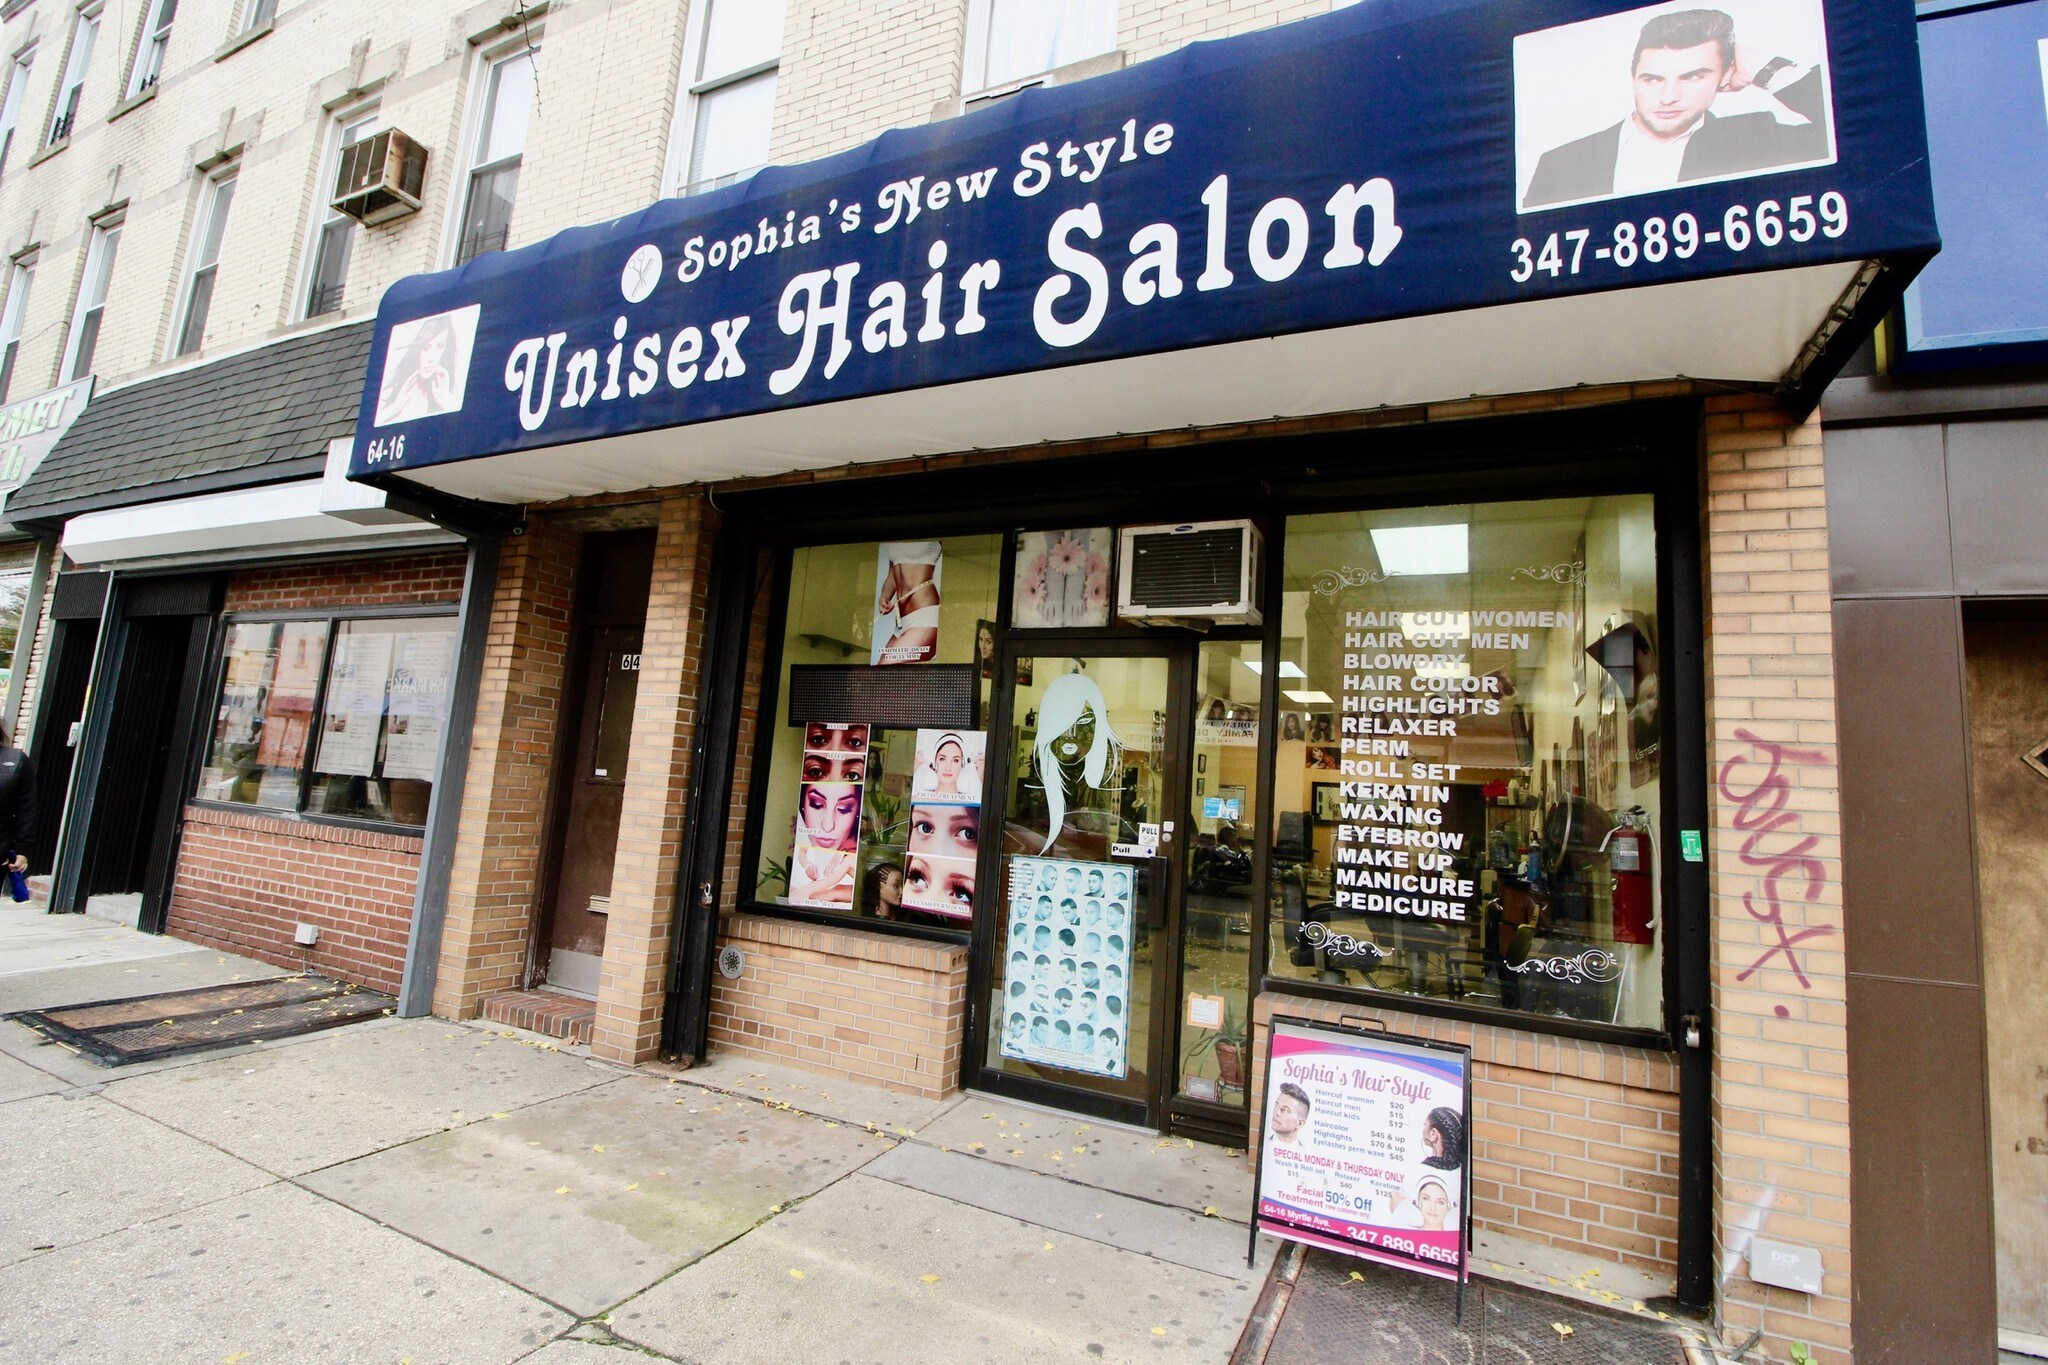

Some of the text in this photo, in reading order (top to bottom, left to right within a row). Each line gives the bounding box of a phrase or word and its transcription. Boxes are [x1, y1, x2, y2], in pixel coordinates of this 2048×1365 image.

[677, 118, 1174, 283] Sophia's New Style
[1509, 190, 1848, 283] 347-889-6659
[504, 174, 1402, 432] Unisex Hair Salon
[366, 434, 405, 466] 64-16
[1345, 611, 1574, 628] HAIR CUT WOMEN
[1344, 632, 1529, 650] HAIR CUT MEN
[1343, 654, 1466, 670] BLOWDRY
[1342, 675, 1499, 693] HAIR COLOR
[1342, 696, 1500, 716] HIGHLIGHTS
[1341, 717, 1457, 736] RELAXER
[1341, 738, 1409, 757] PERM
[1340, 759, 1462, 781] ROLL SET
[1339, 781, 1450, 803] KERATIN
[1340, 802, 1442, 825] WAXING
[1141, 826, 1158, 835] PULL
[1338, 824, 1464, 850] EYEBROW
[1337, 847, 1453, 871] MAKE UP
[1336, 868, 1474, 897] MANICURE
[1335, 890, 1466, 921] PEDICURE
[1283, 1057, 1432, 1104] Sophia's New Style
[1315, 1089, 1404, 1110] Haircut woman $20
[1315, 1098, 1404, 1119] Haircut men $15
[1315, 1106, 1403, 1128] Haircut kids $12
[1314, 1120, 1349, 1132] Haircolor
[1371, 1130, 1385, 1139] $45
[1314, 1129, 1353, 1142] Highlights
[1370, 1140, 1384, 1148] $70
[1313, 1138, 1404, 1161] Eyelashes perm wave $45
[1273, 1147, 1405, 1183] SPECIAL MONDAY & THURSDAY ONLY
[1275, 1159, 1292, 1168] Wash
[1300, 1164, 1313, 1172] Roll
[1287, 1170, 1299, 1178] $15
[1340, 1181, 1352, 1189] $40
[1376, 1189, 1392, 1198] $125
[1277, 1189, 1324, 1208] Treatment
[1296, 1185, 1373, 1211] Facial 50% Off
[1264, 1204, 1286, 1216] 64-16
[1287, 1209, 1312, 1222] Myrtle
[1313, 1216, 1331, 1227] Ave.
[1347, 1226, 1459, 1265] 347889.6659
